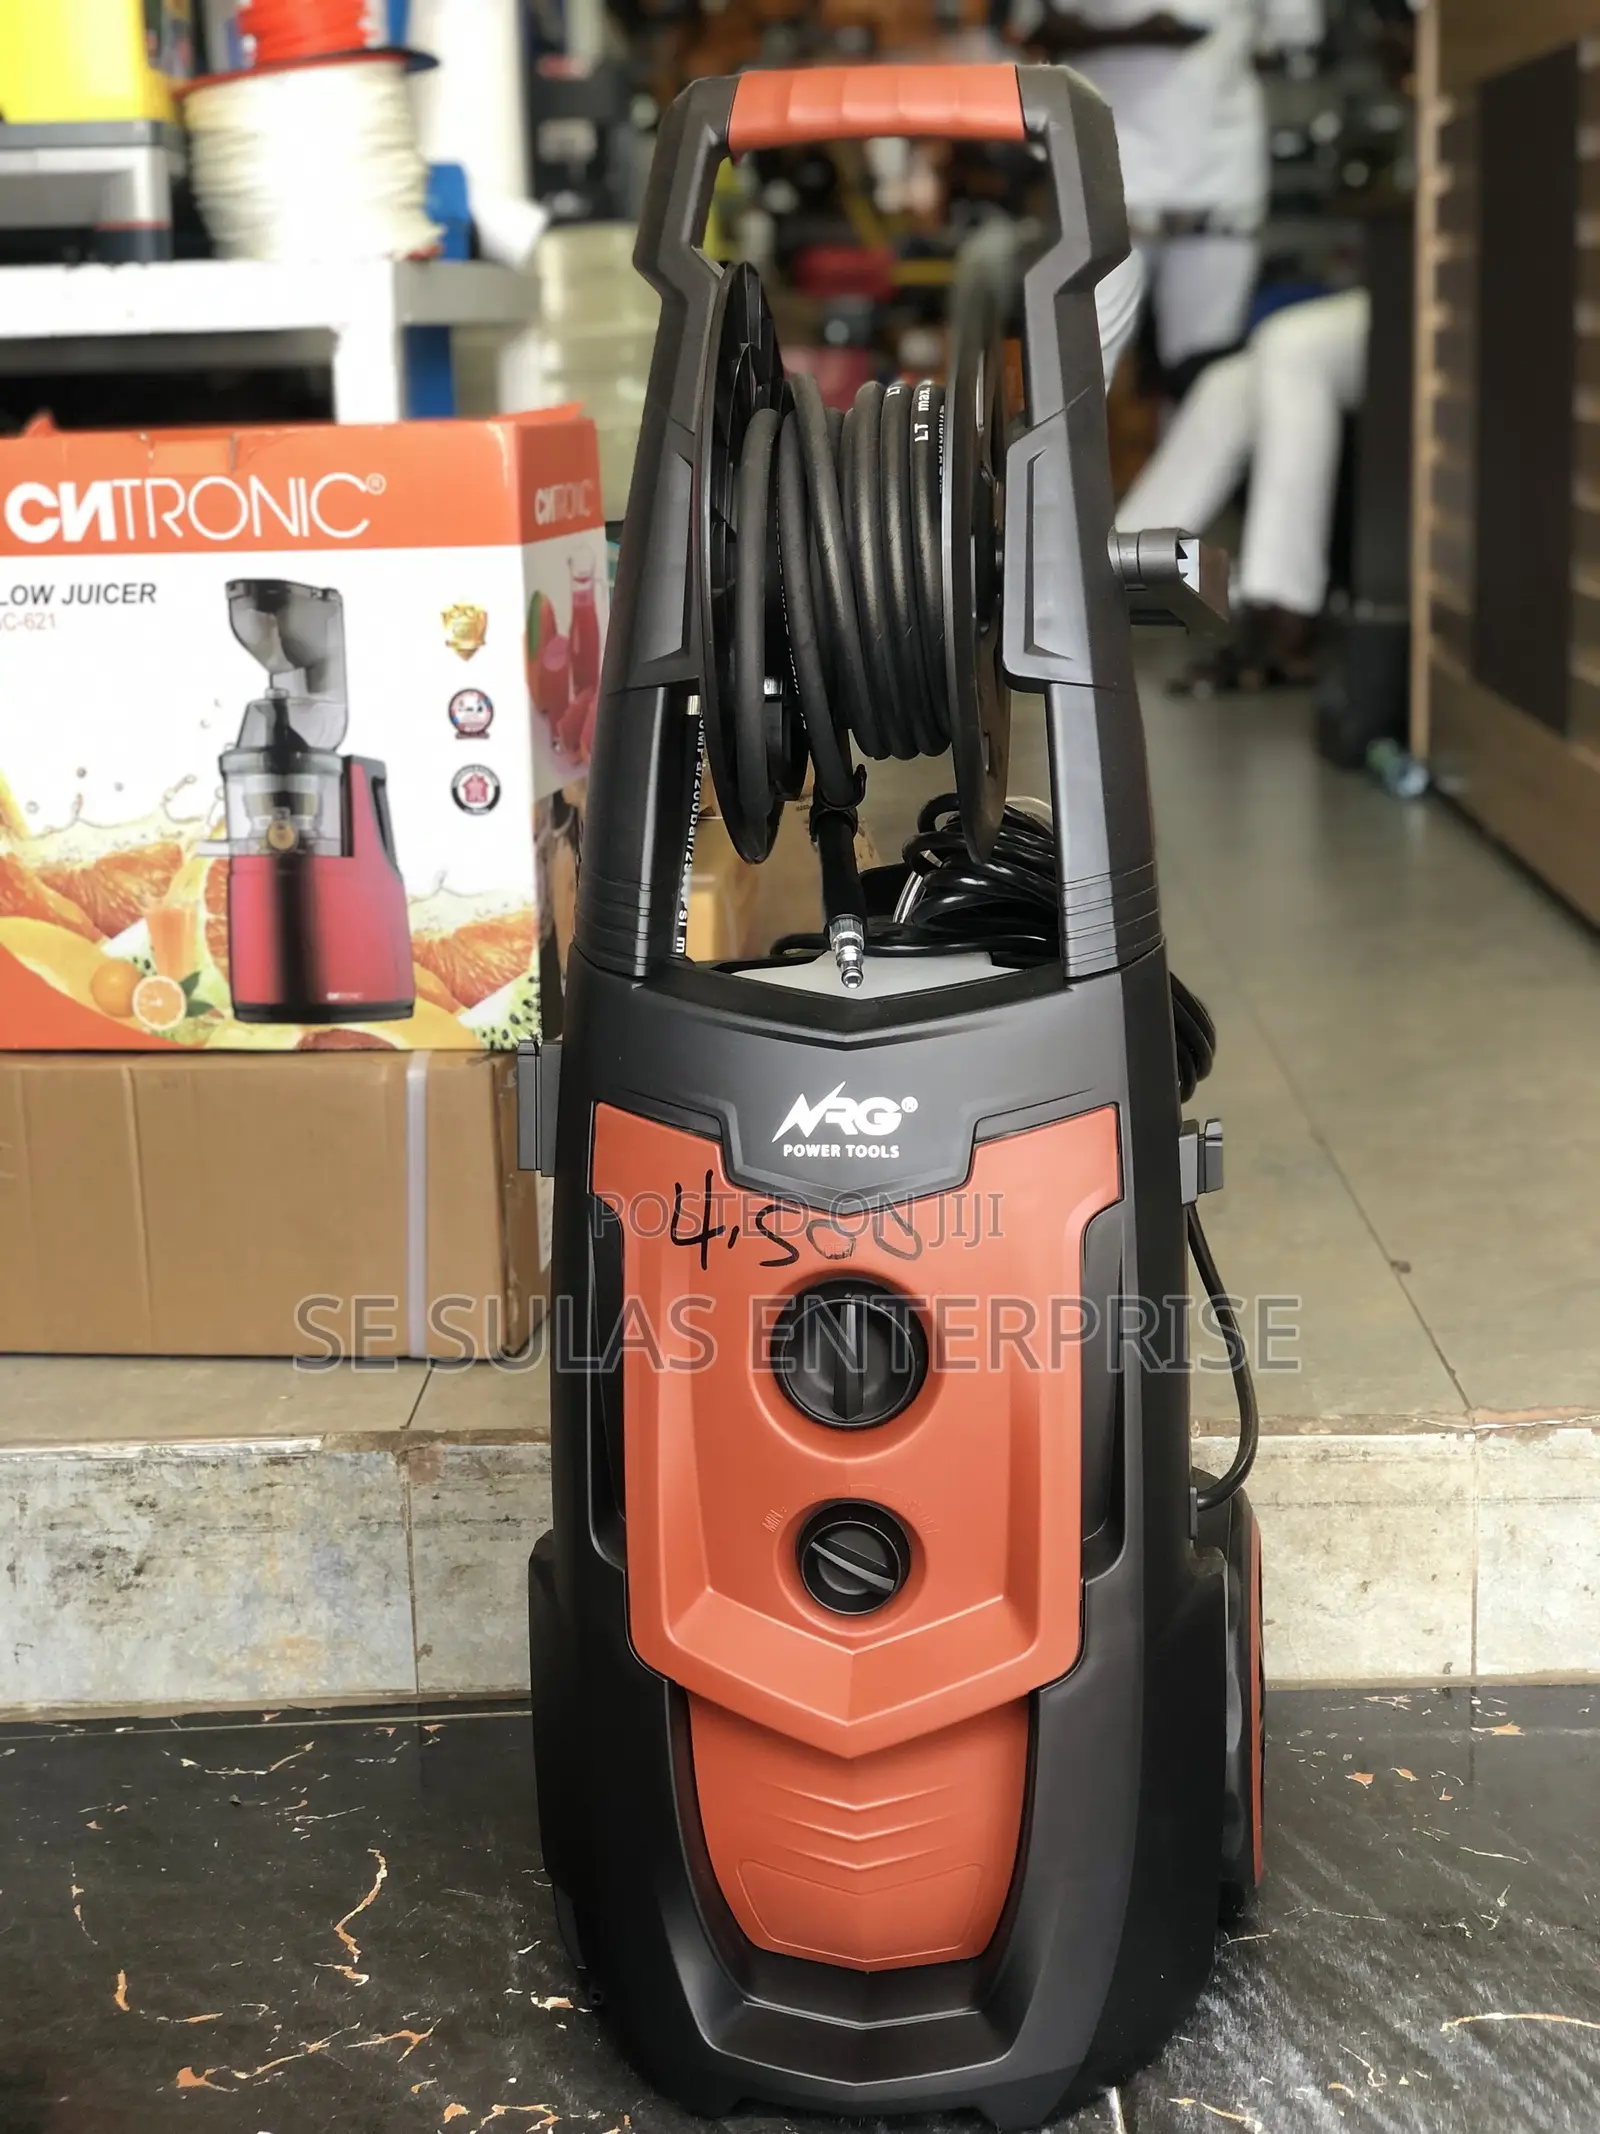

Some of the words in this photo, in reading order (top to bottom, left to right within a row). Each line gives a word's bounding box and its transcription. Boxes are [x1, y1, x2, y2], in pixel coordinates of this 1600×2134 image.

[914, 423, 929, 442] LT
[62, 582, 156, 605] JUICER
[772, 1081, 902, 1143] NRG
[783, 1144, 841, 1158] POWER
[845, 1144, 900, 1159] TOOLS
